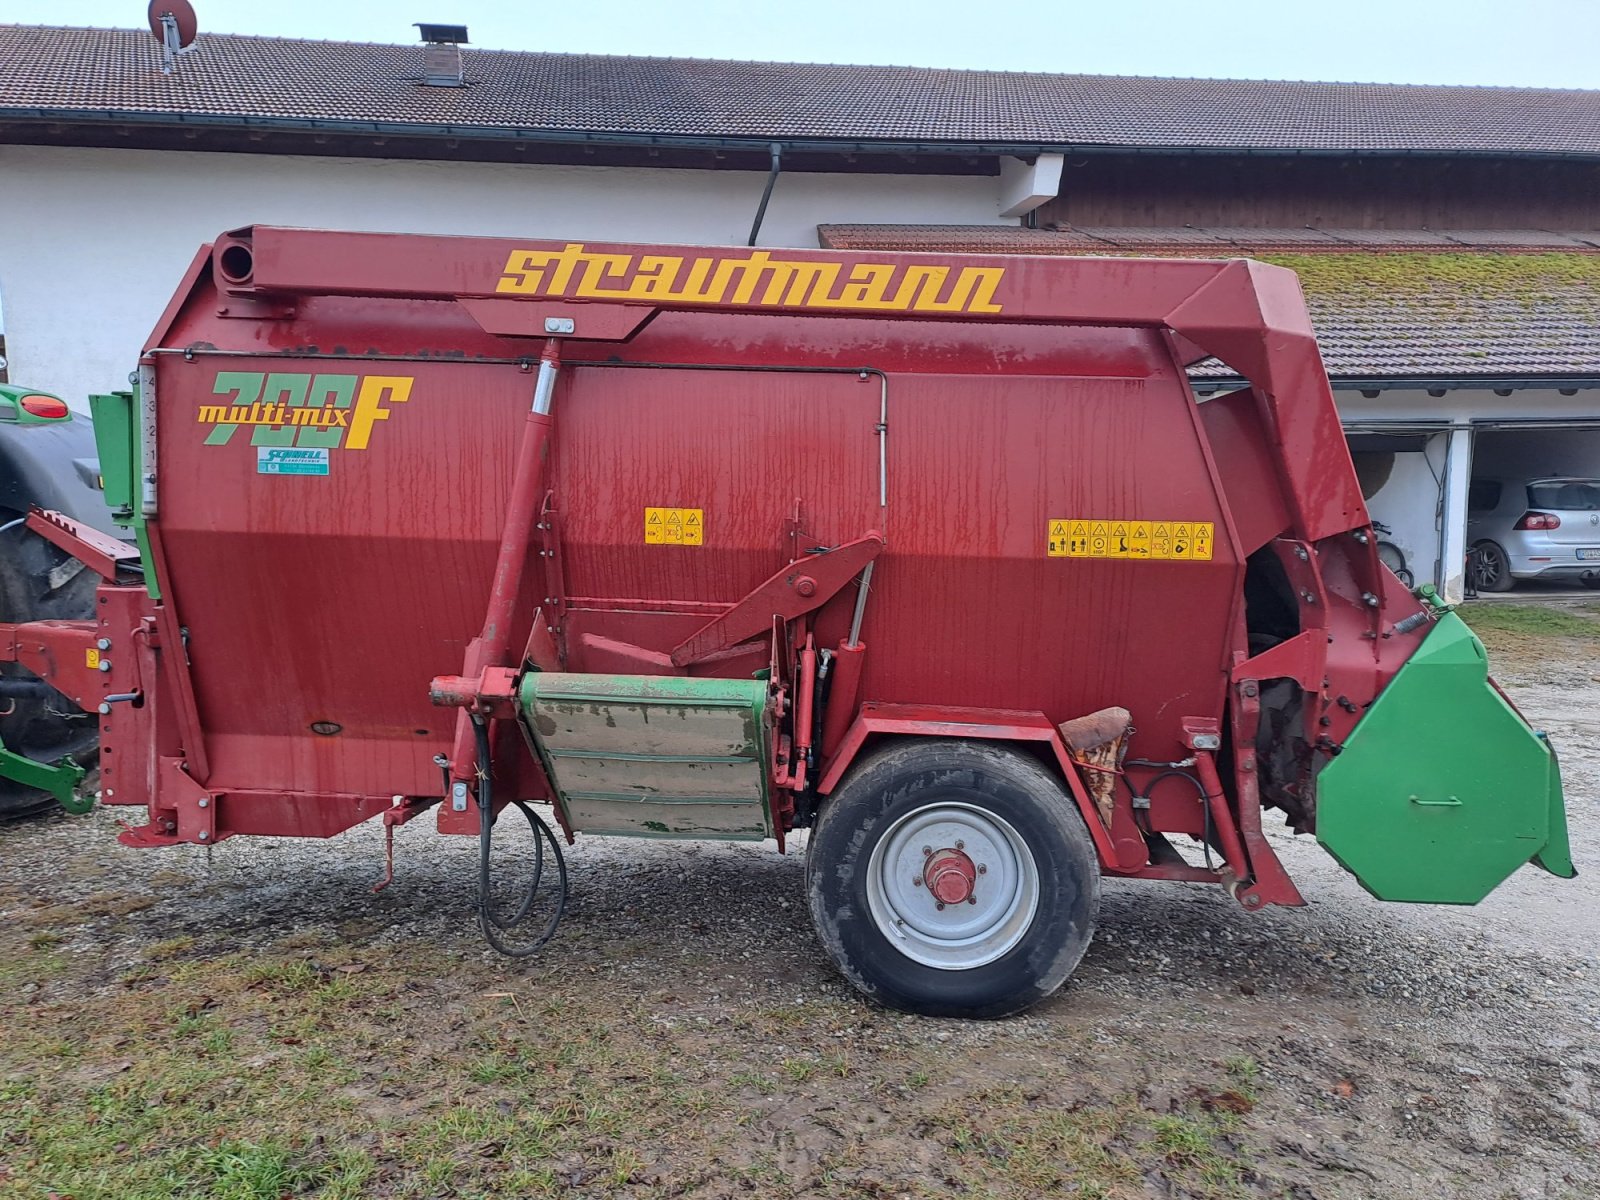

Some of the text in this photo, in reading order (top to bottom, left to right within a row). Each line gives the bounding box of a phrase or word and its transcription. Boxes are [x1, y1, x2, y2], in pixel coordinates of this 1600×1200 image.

[496, 243, 1005, 313] strautmann
[148, 377, 155, 386] 4
[148, 400, 155, 412] 3
[197, 402, 350, 427] multi-mix
[149, 425, 155, 436] 2
[150, 449, 155, 460] 1
